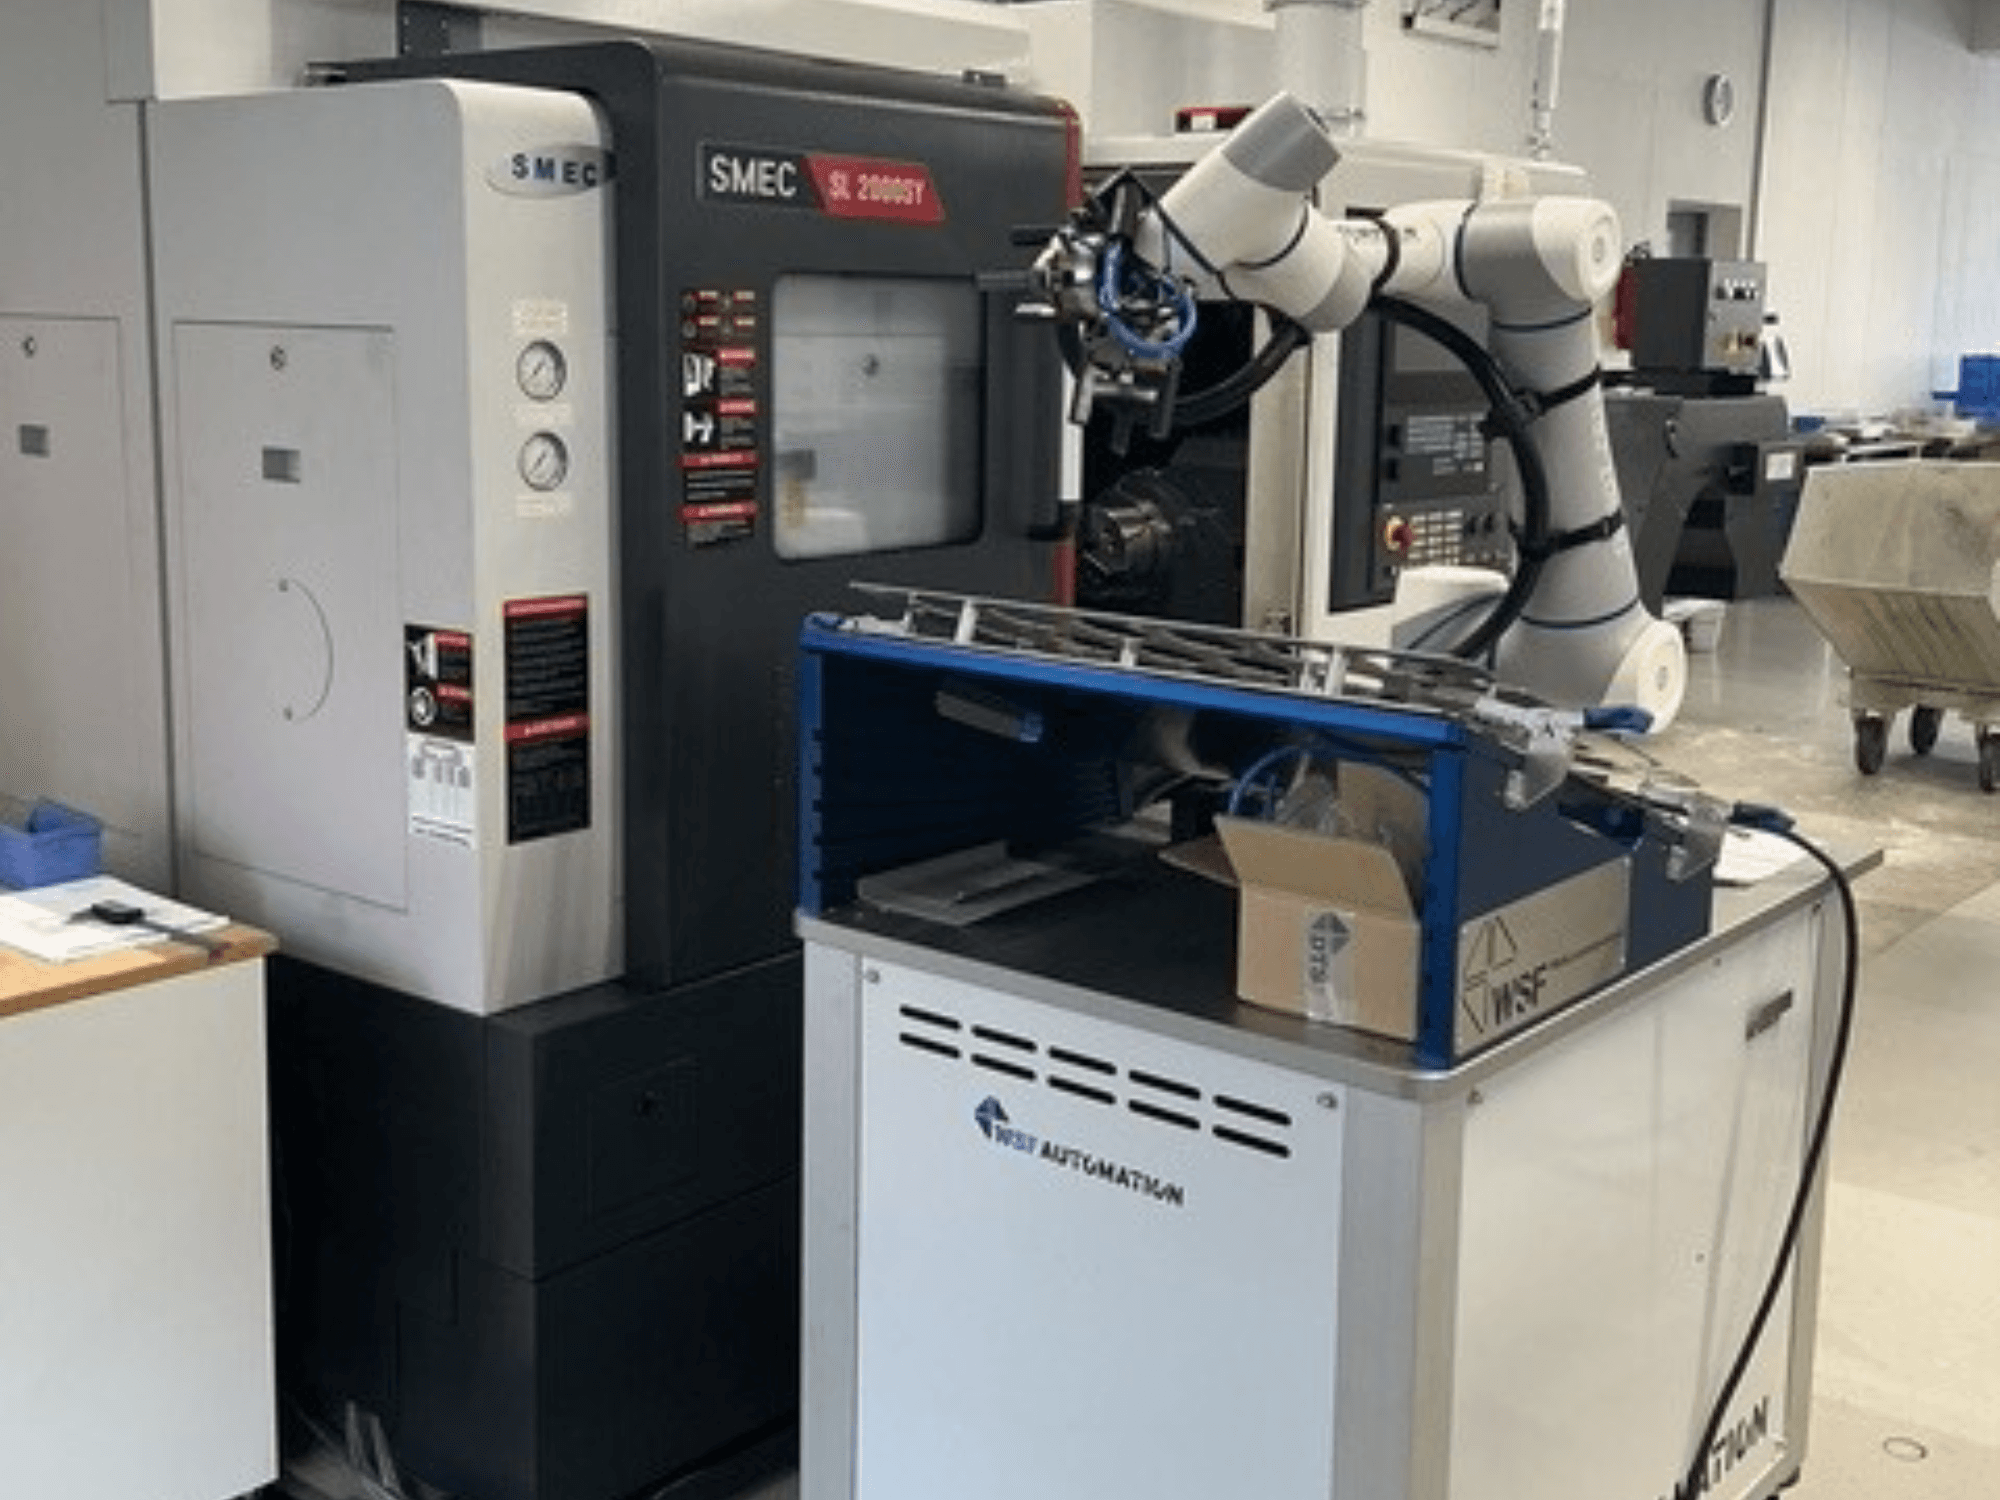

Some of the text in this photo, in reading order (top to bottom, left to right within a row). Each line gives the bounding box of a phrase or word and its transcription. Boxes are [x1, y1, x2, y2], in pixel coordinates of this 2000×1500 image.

[511, 153, 598, 188] SMEC
[709, 154, 797, 198] SMEC
[1490, 962, 1547, 1027] WSF
[1040, 1140, 1185, 1207] AUTOMATION
